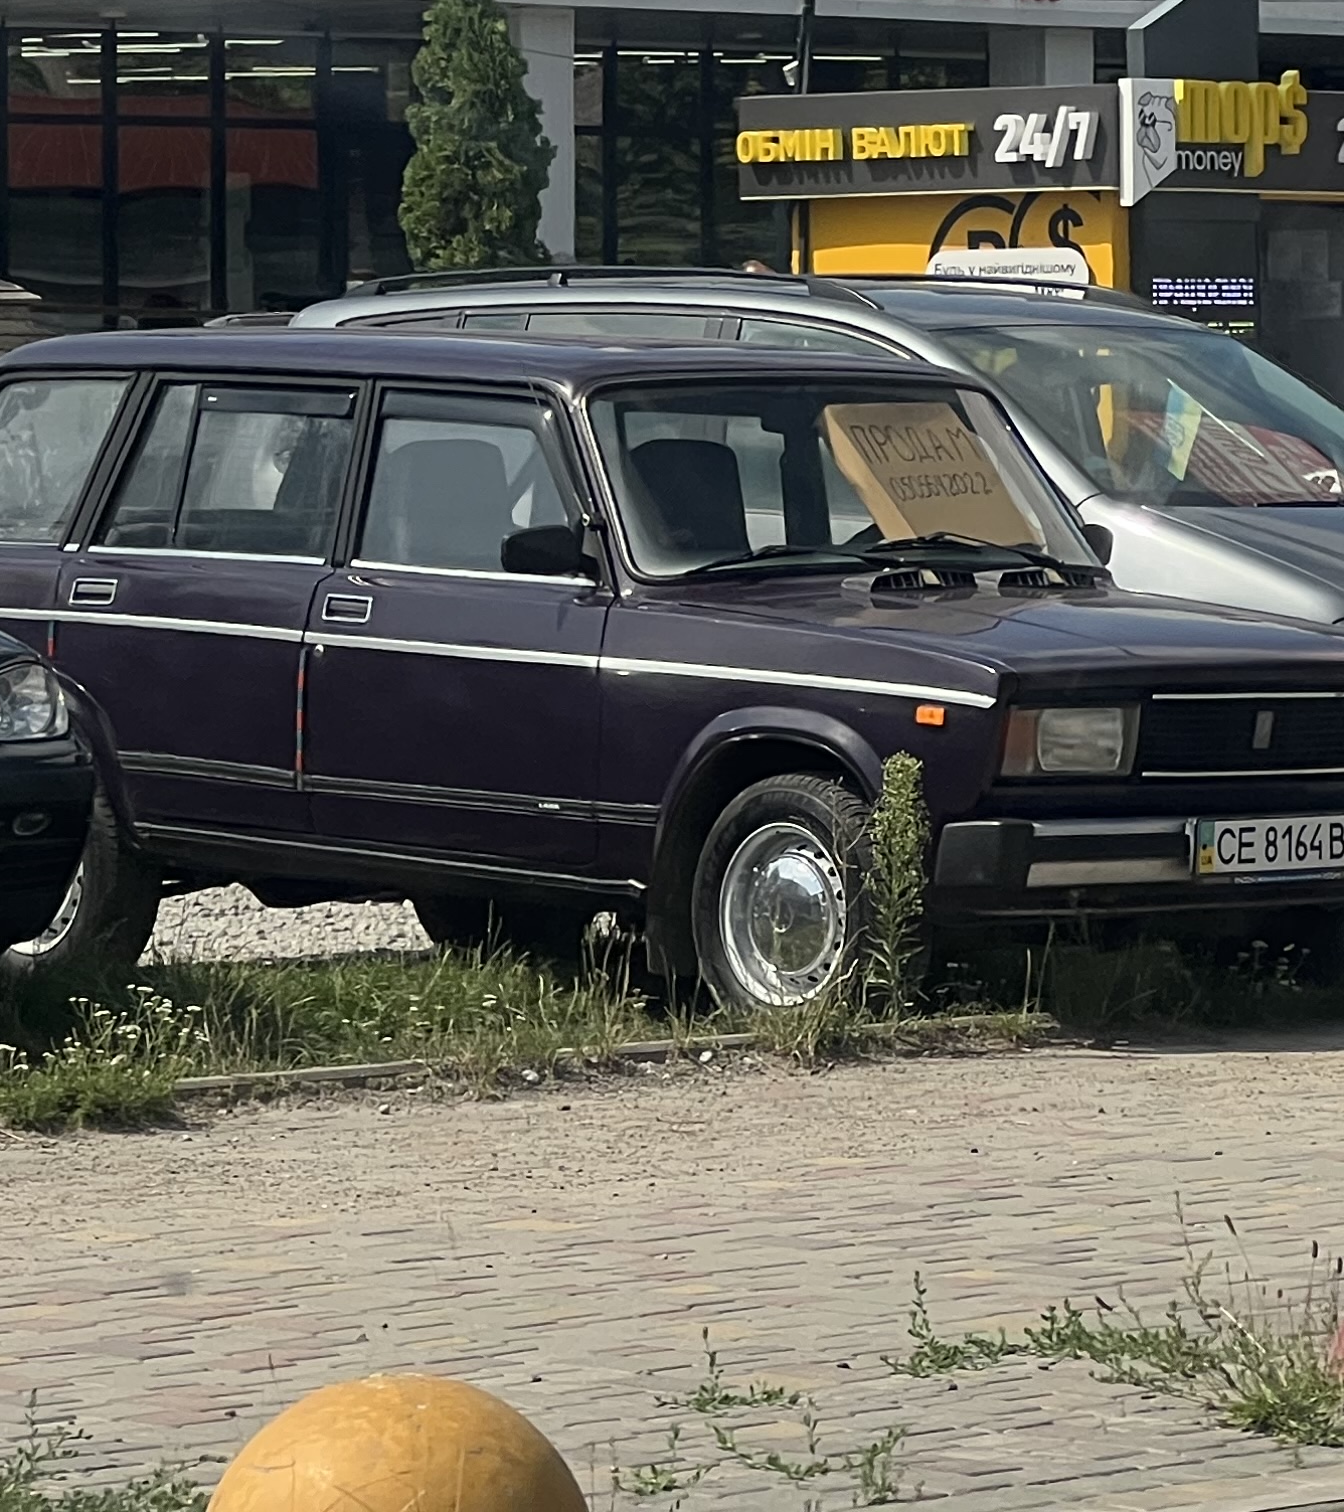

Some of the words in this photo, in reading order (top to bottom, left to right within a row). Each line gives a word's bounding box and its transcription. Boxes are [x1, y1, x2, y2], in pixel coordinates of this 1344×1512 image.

[736, 127, 843, 164] ОБМІН
[852, 122, 975, 160] ВАЛЮТ
[993, 104, 1099, 168] 24/7
[1176, 148, 1242, 177] money
[850, 424, 984, 464] ПРОДАМ
[1217, 827, 1256, 865] CE
[1264, 823, 1323, 863] 8164
